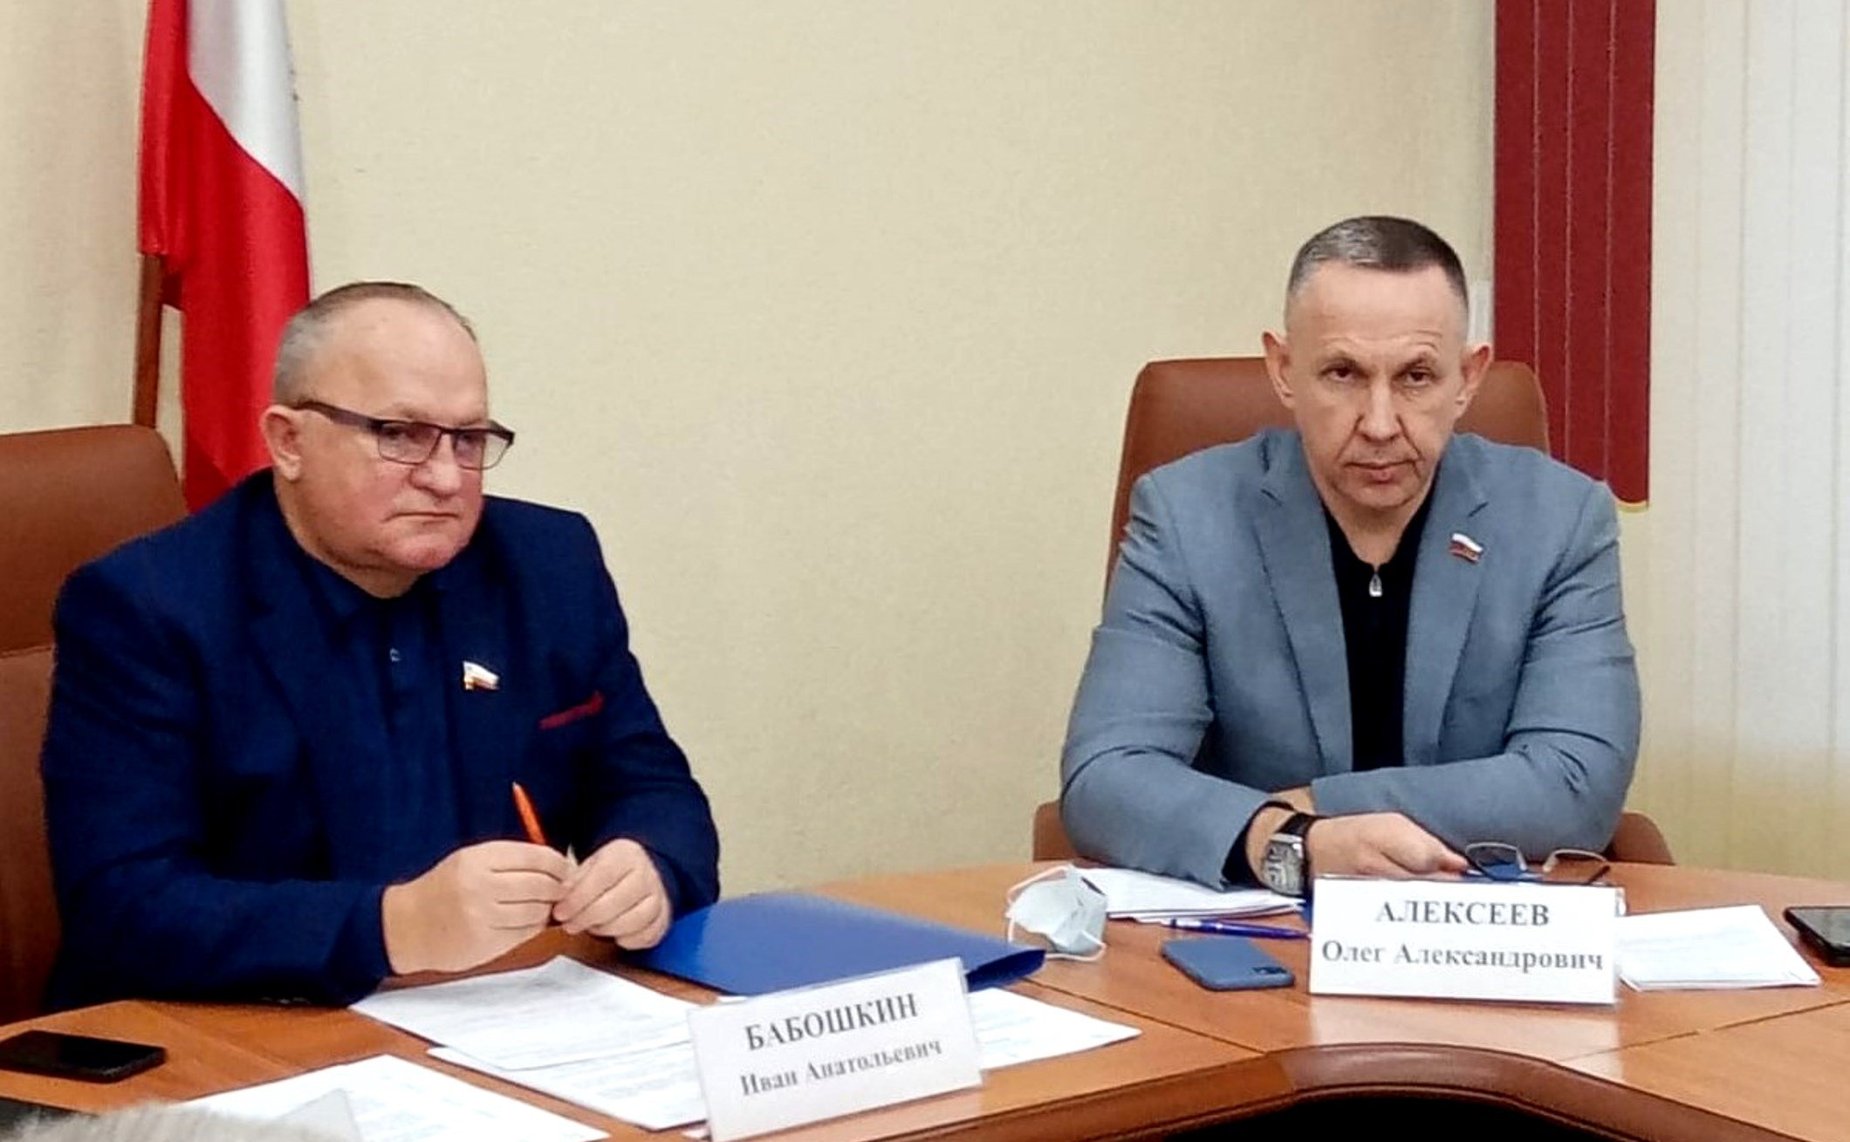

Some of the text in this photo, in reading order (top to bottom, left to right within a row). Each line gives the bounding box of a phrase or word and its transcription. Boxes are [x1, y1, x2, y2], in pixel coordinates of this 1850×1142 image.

[1376, 900, 1550, 927] АЛЕКСЕЕВ
[1322, 940, 1384, 964] Олег
[1394, 944, 1603, 973] Александрович
[745, 993, 919, 1051] БАБОШКИН
[740, 1039, 942, 1096] Иван Анатольевич
